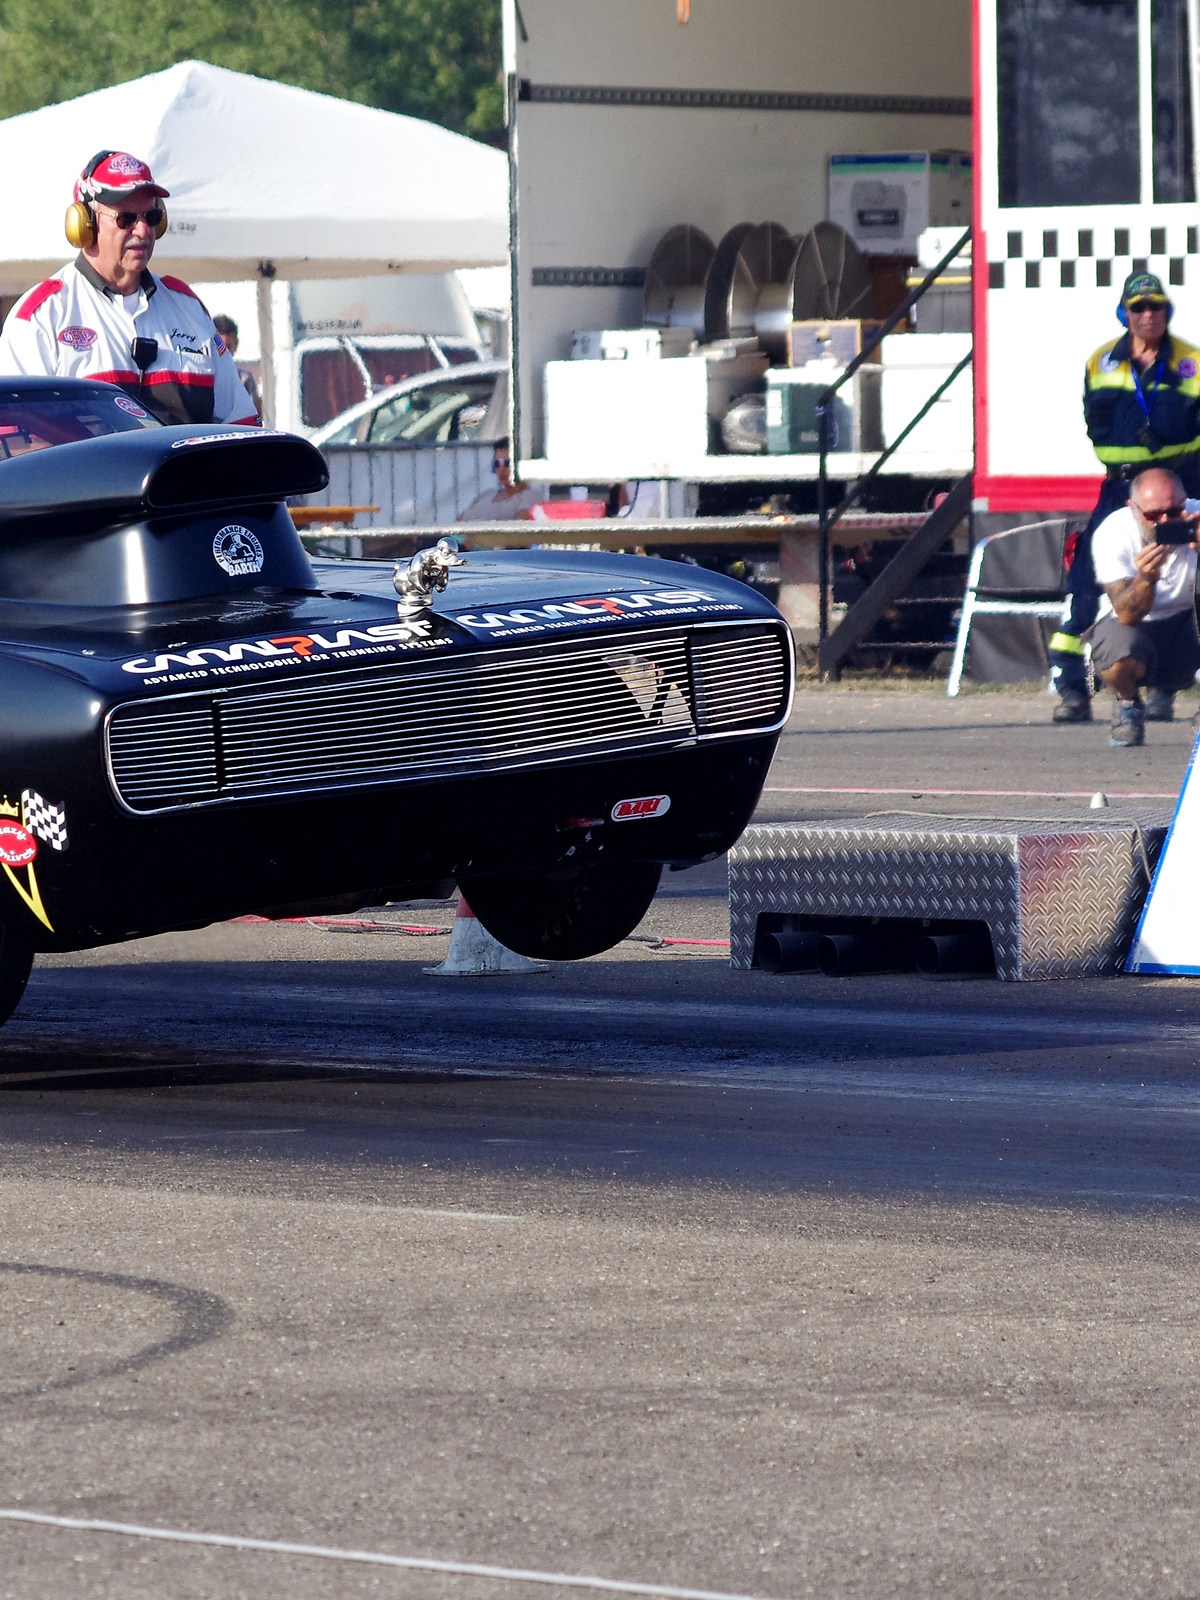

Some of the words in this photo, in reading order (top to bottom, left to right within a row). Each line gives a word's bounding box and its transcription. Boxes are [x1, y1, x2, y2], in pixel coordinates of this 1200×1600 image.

[170, 328, 197, 343] Jerry
[213, 525, 243, 563] PERFORMANCE
[228, 561, 262, 577] BARTH
[490, 623, 547, 638] ADVANCED
[544, 614, 622, 630] TECHNOLOGIES
[620, 610, 645, 621] FOR
[645, 605, 698, 618] TRUNKING
[696, 603, 744, 613] SYSTEMS
[143, 667, 209, 685] ADVANCED
[209, 657, 303, 676] TECHNOLOGIES
[304, 651, 331, 664] FOR
[331, 643, 397, 660] TRUNKING
[397, 636, 455, 652] SYSTEMS
